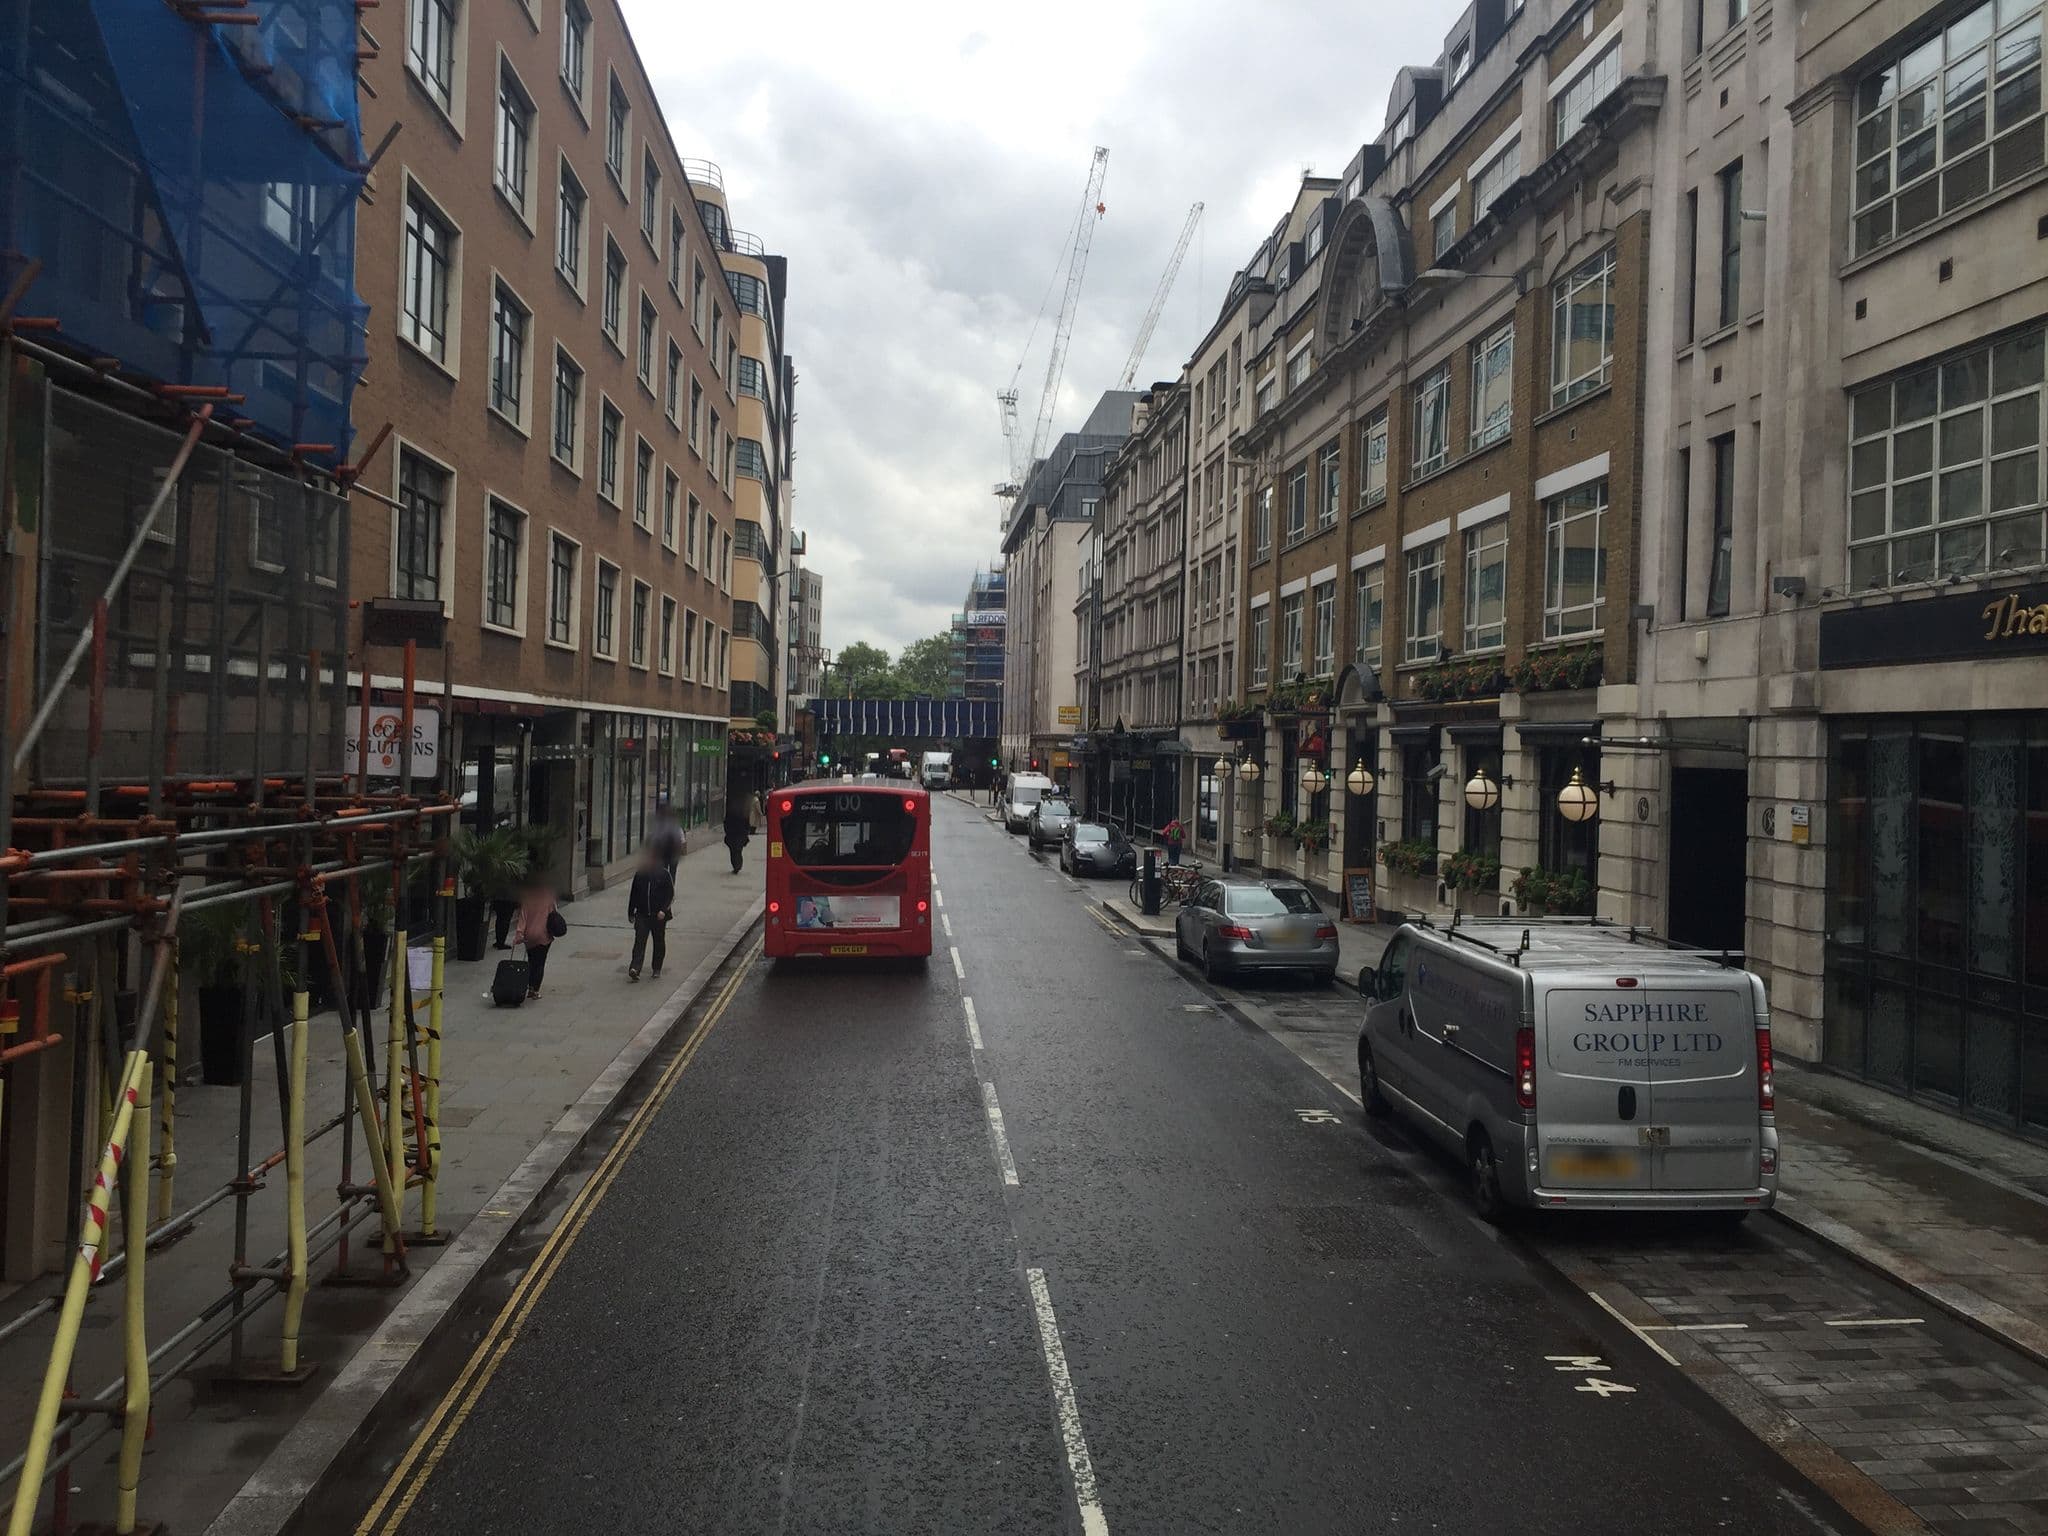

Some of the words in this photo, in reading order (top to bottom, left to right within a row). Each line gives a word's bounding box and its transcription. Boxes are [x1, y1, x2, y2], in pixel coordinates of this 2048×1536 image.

[346, 739, 434, 757] SLUTINS
[834, 794, 861, 812] 100
[1584, 1003, 1709, 1023] SAPPHIRE
[1573, 1032, 1666, 1053] GROUP
[1672, 1033, 1722, 1053] LTD
[1618, 1057, 1633, 1067] FM
[1633, 1057, 1681, 1067] SERVICES
